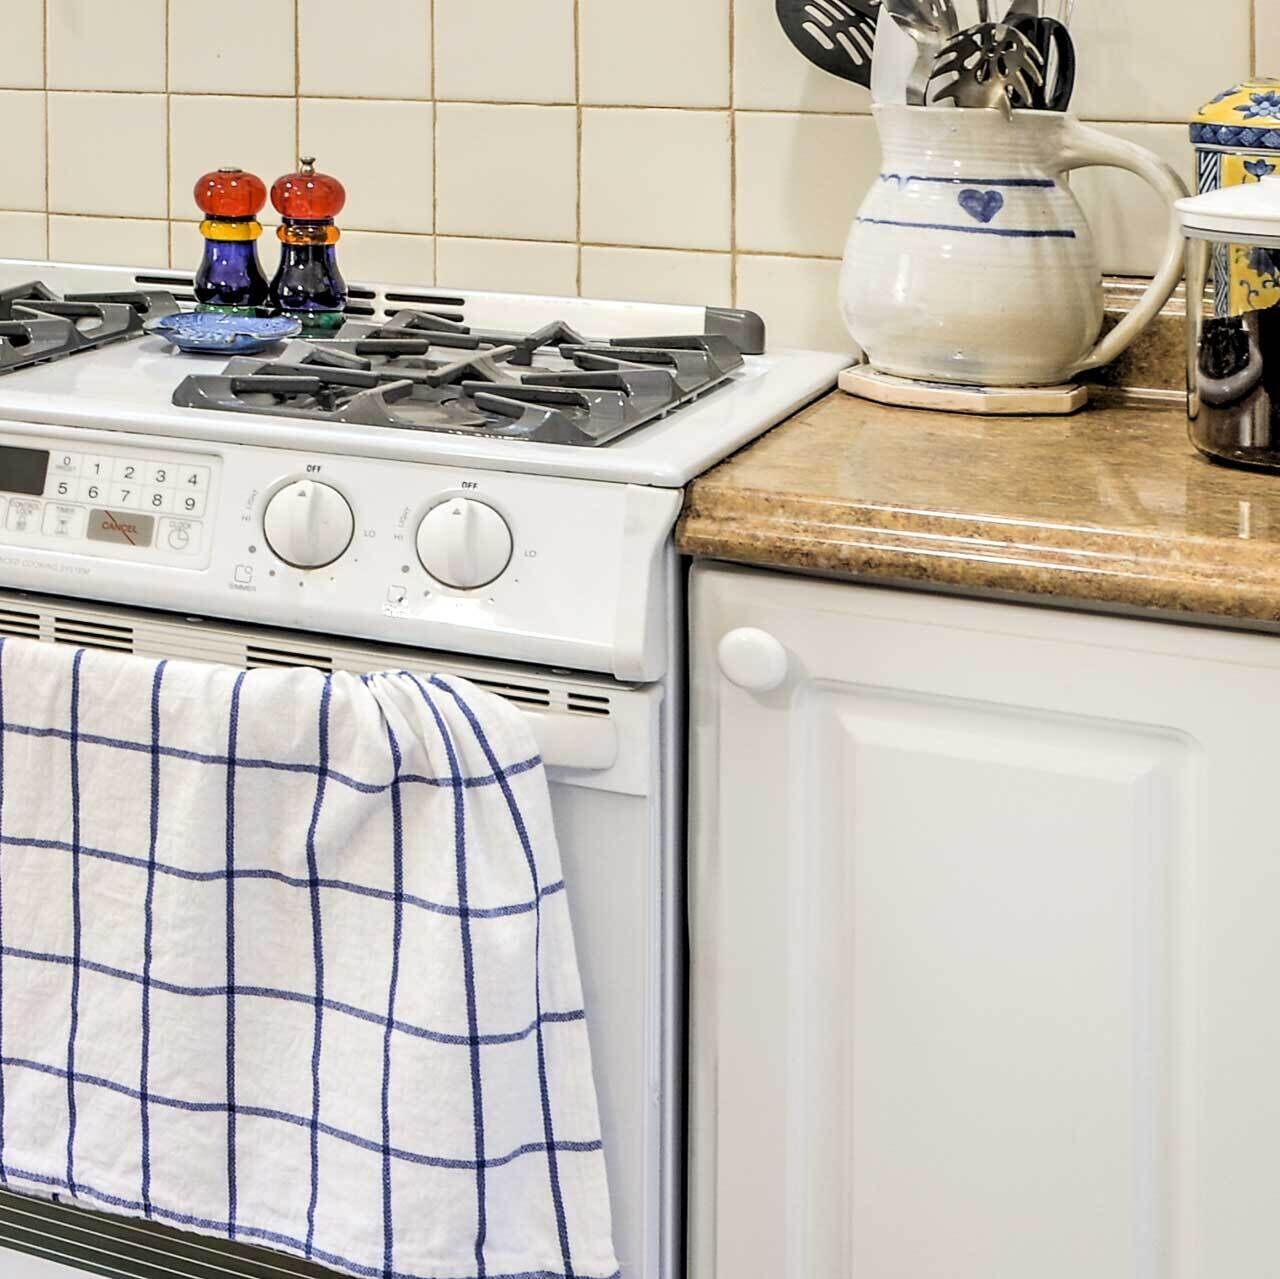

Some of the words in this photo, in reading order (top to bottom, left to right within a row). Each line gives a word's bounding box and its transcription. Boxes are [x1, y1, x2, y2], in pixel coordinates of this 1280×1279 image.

[63, 455, 72, 466] 0
[94, 463, 101, 475] 1
[124, 466, 135, 480] 2
[155, 469, 167, 483] 3
[187, 474, 198, 488] 4
[305, 463, 322, 473] OFF
[461, 481, 479, 490] OFF
[57, 482, 69, 496] 5
[88, 486, 100, 499] 6
[120, 489, 131, 503] 7
[151, 493, 163, 507] 8
[184, 497, 196, 511] 9
[101, 520, 138, 535] CANCEL
[363, 528, 377, 538] LO
[523, 548, 538, 559] LO
